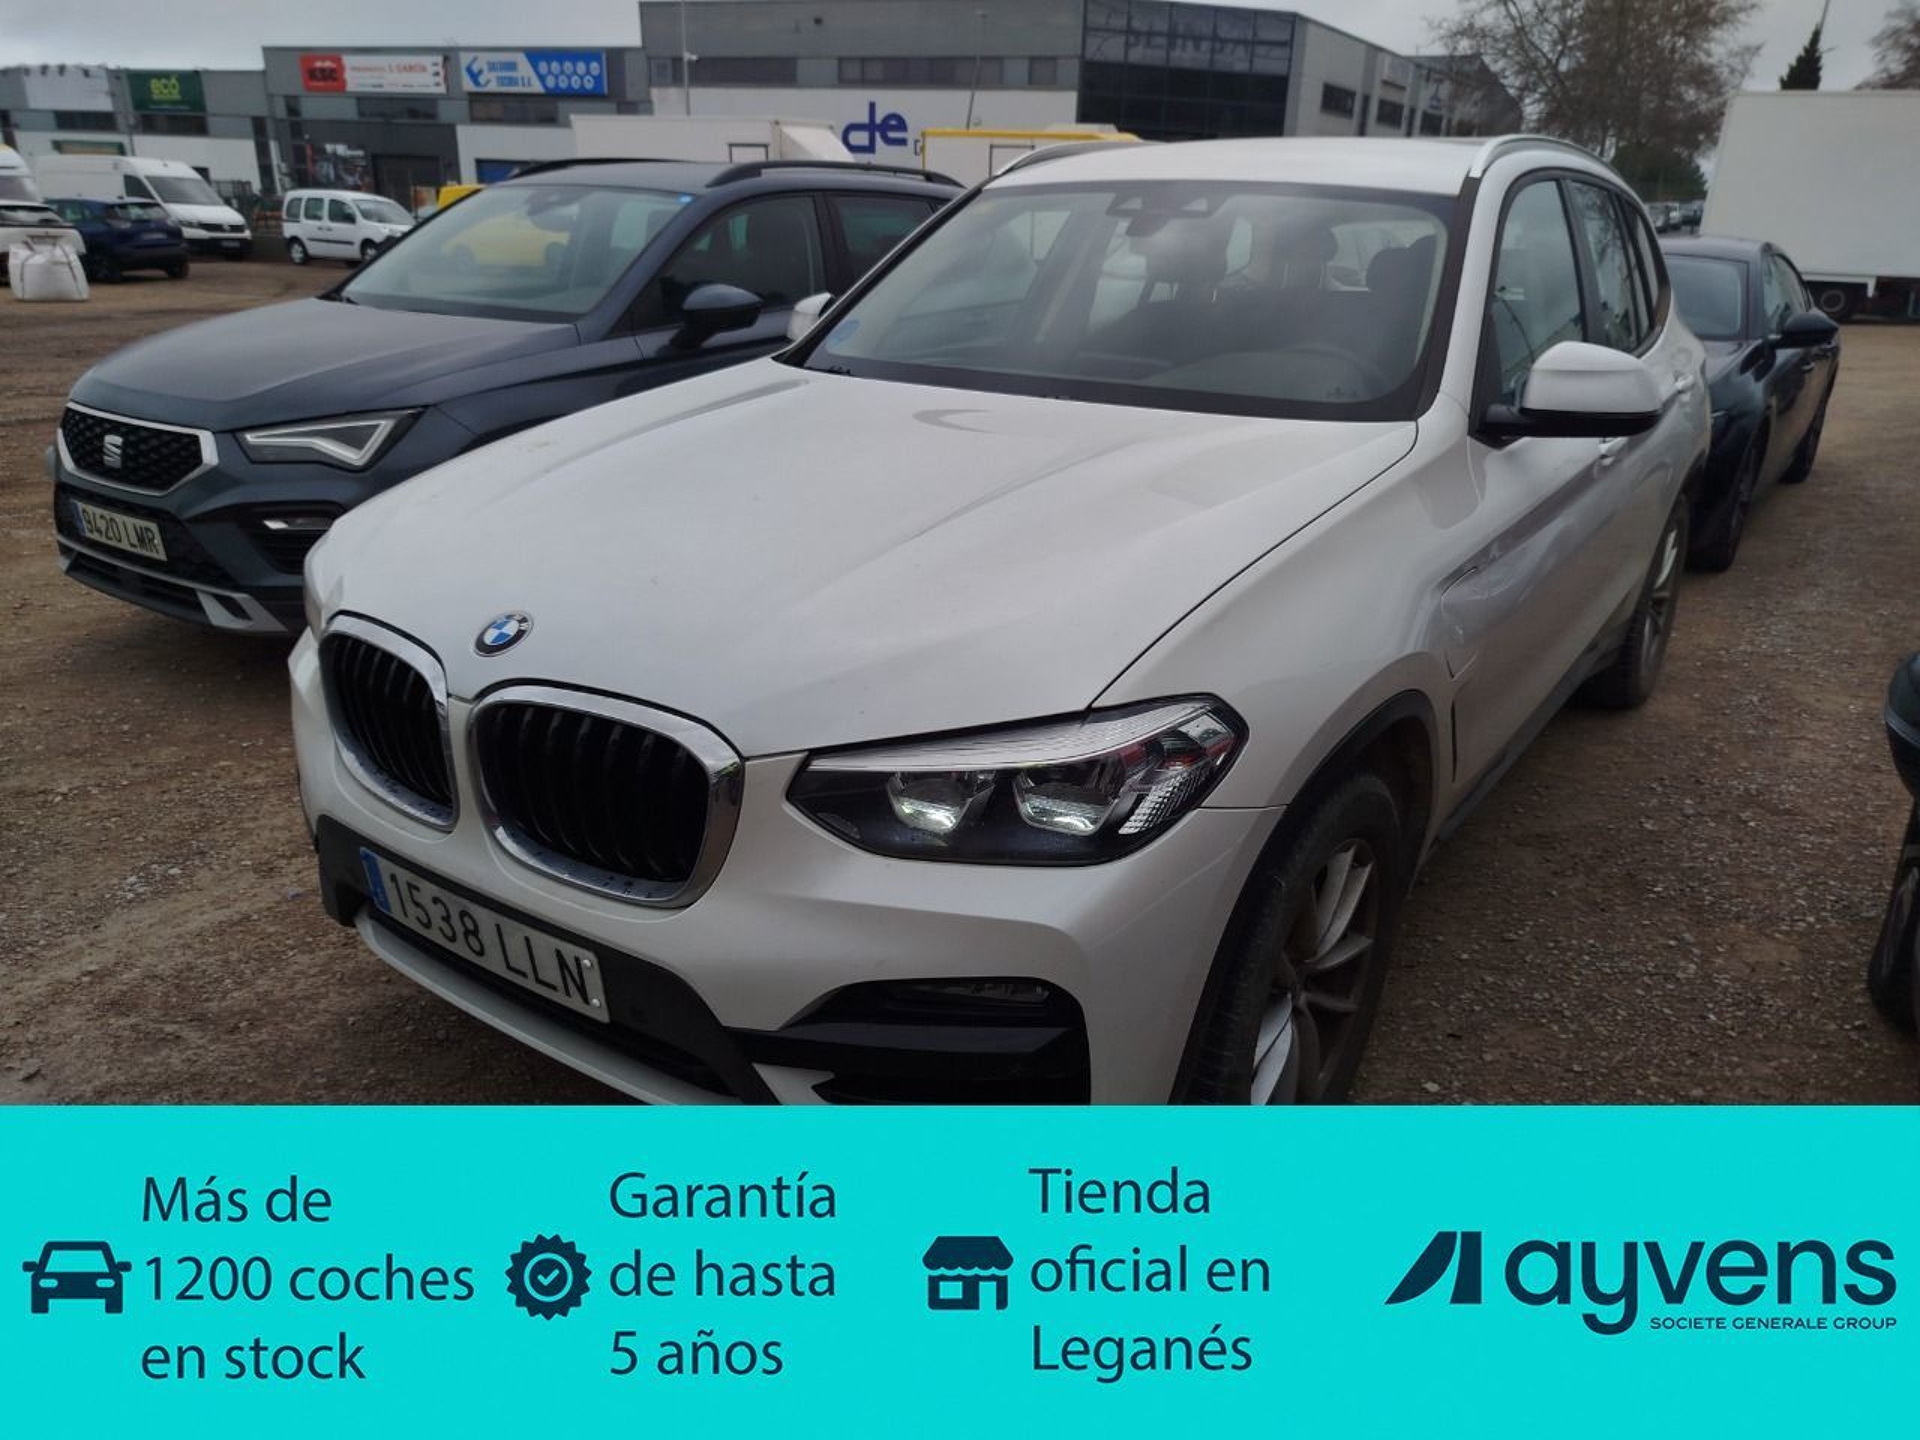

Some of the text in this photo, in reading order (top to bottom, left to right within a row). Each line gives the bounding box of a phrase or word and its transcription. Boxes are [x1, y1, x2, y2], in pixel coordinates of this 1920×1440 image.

[82, 507, 160, 555] 9420 LMR
[390, 872, 589, 1006] 1538 LLN
